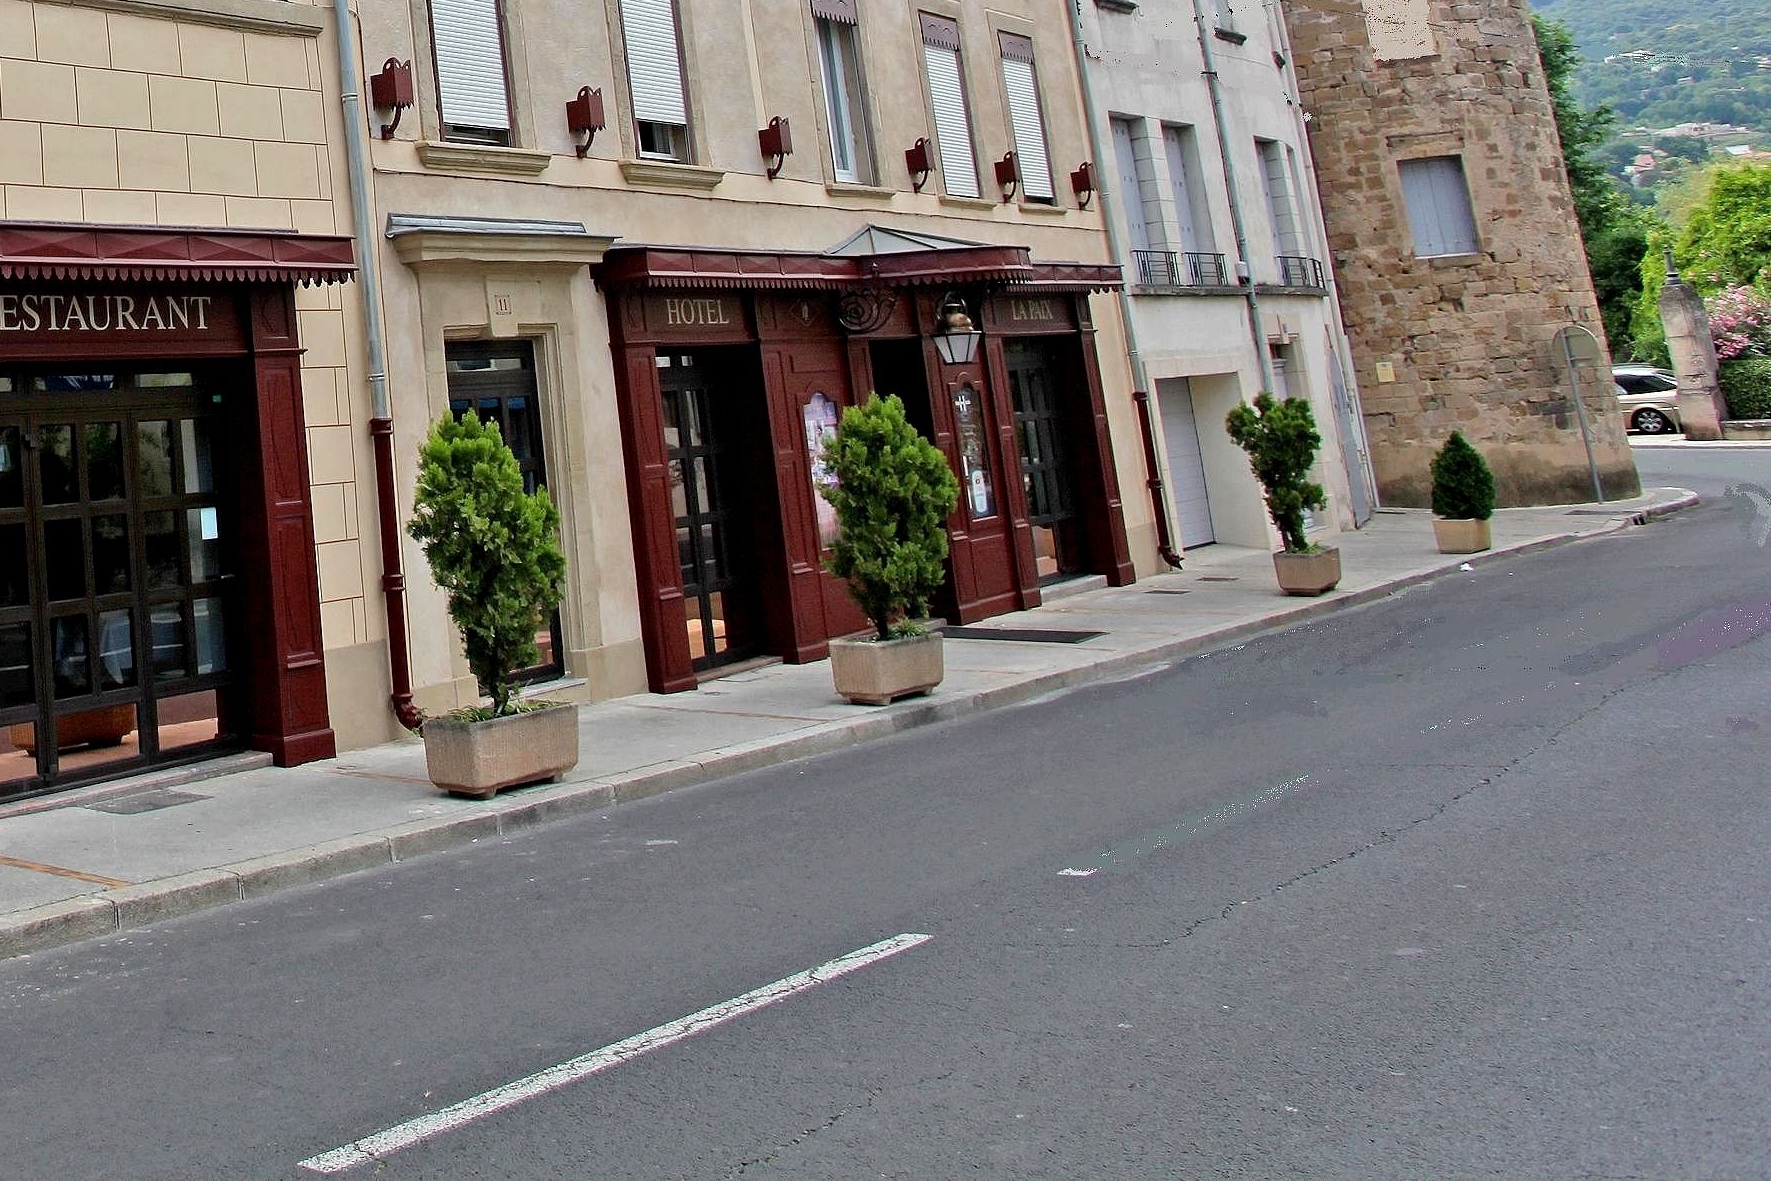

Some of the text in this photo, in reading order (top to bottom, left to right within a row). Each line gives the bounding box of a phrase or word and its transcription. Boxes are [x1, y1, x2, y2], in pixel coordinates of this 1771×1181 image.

[666, 298, 730, 325] HOTEL
[1011, 299, 1054, 320] LA PAIX
